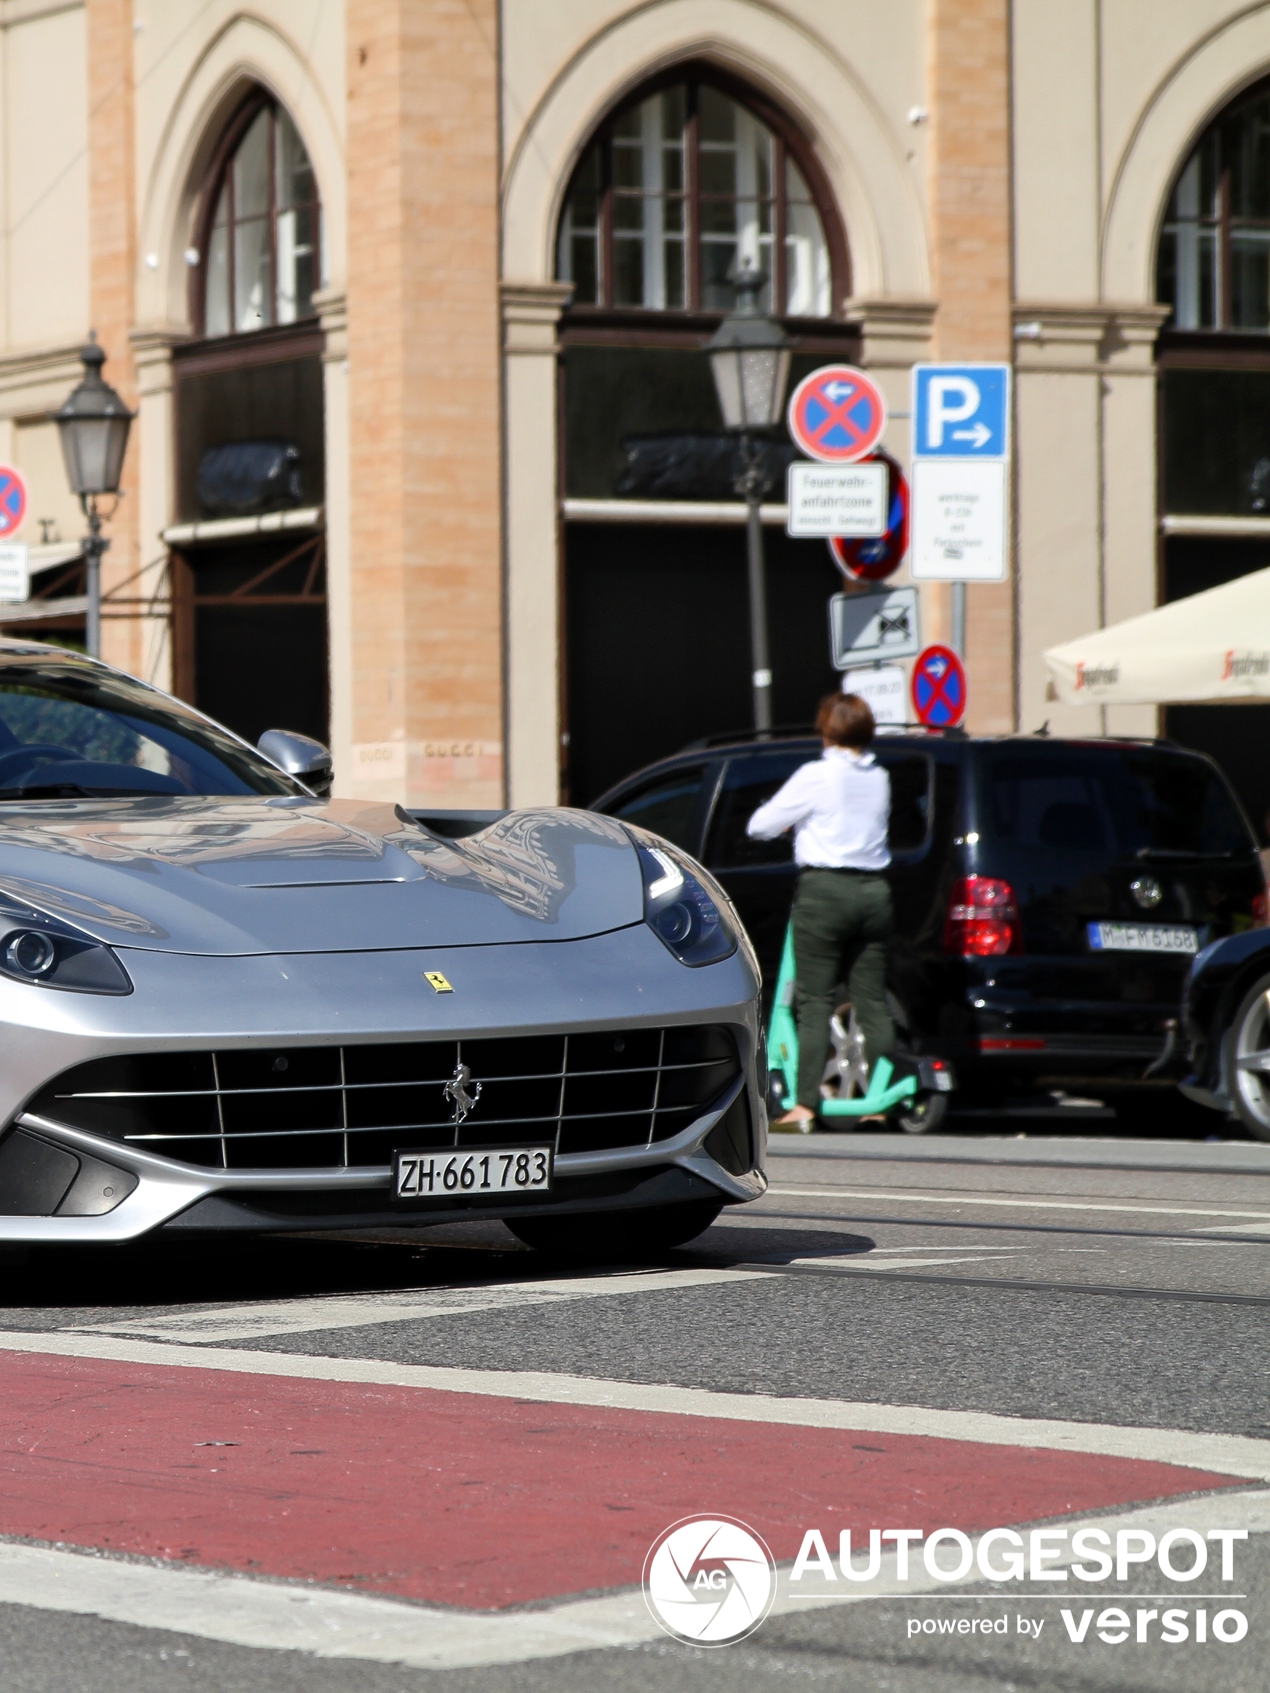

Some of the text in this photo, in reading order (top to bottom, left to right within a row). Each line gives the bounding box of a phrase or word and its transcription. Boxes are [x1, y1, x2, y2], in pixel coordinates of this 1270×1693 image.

[927, 375, 981, 448] P
[802, 474, 873, 488] Feuerwehr-
[801, 494, 873, 508] anfahrtzone
[425, 743, 483, 758] GUCCI
